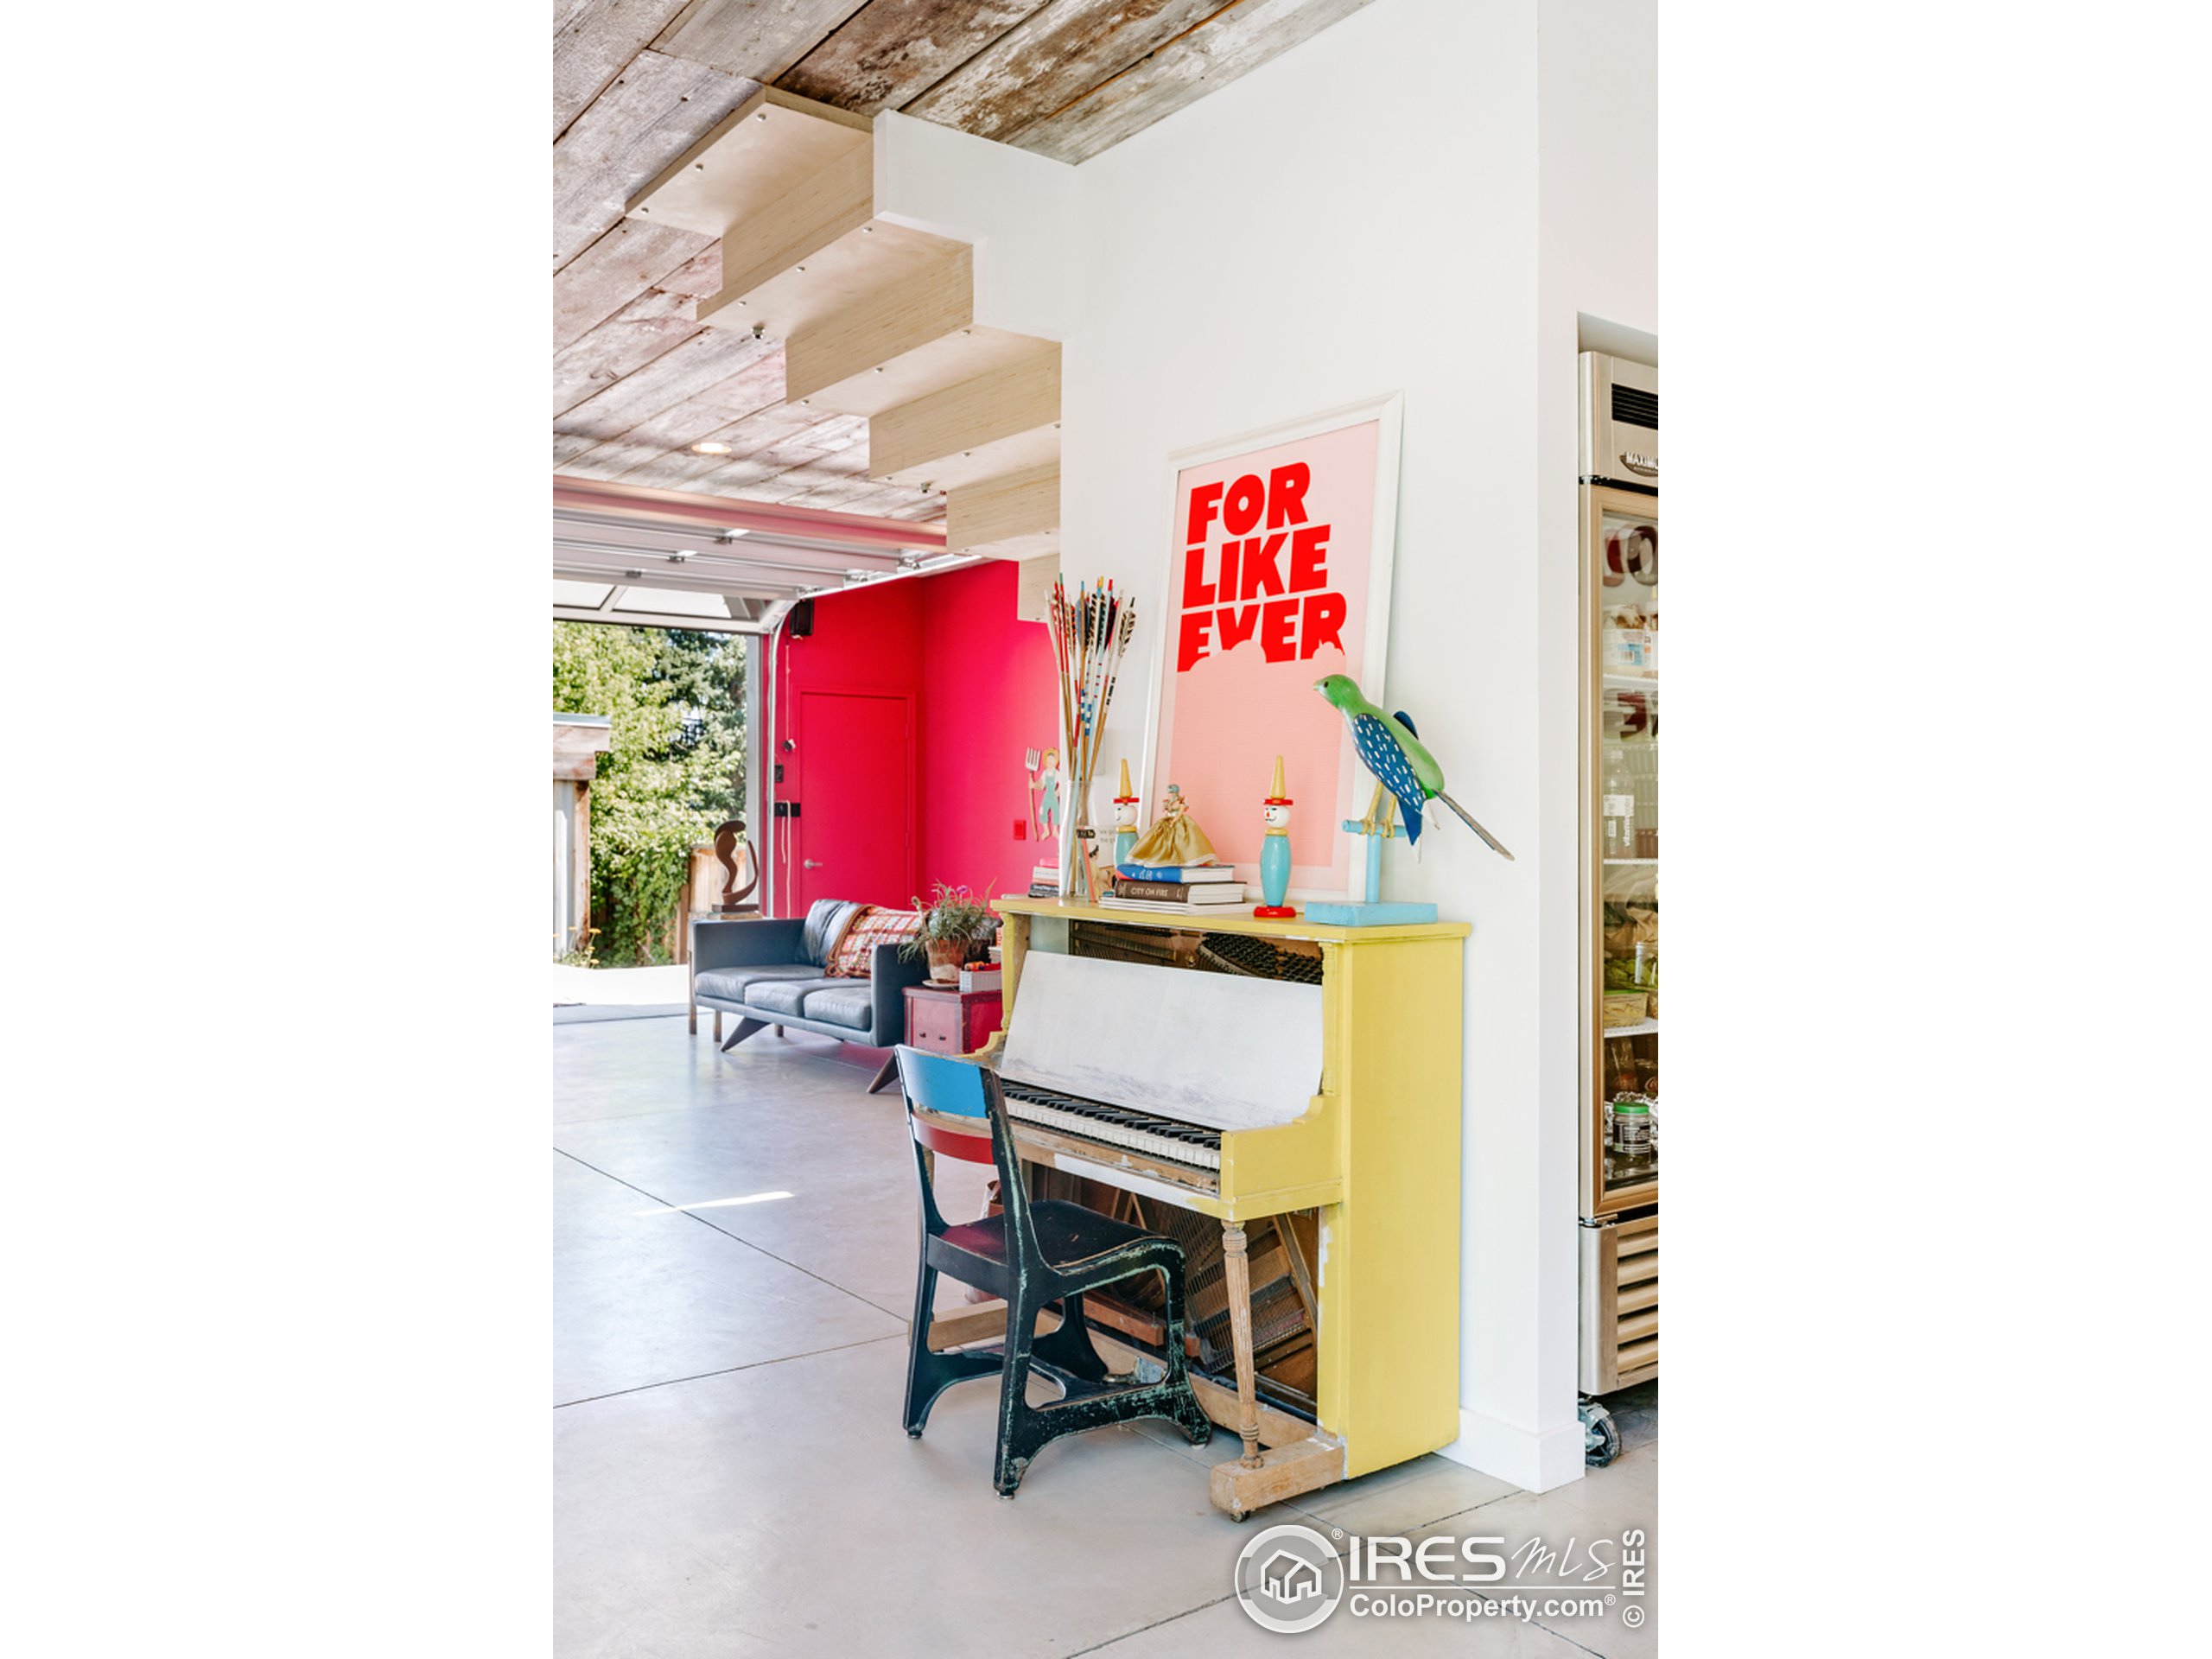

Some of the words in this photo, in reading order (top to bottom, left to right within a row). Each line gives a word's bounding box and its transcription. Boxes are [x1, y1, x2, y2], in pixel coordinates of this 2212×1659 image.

[1186, 461, 1311, 546] FOR
[1182, 524, 1332, 610] LIKE
[1177, 592, 1347, 673] EVER
[1130, 887, 1145, 896] CITY
[1145, 887, 1155, 896] ON
[1155, 887, 1169, 898] FIRE
